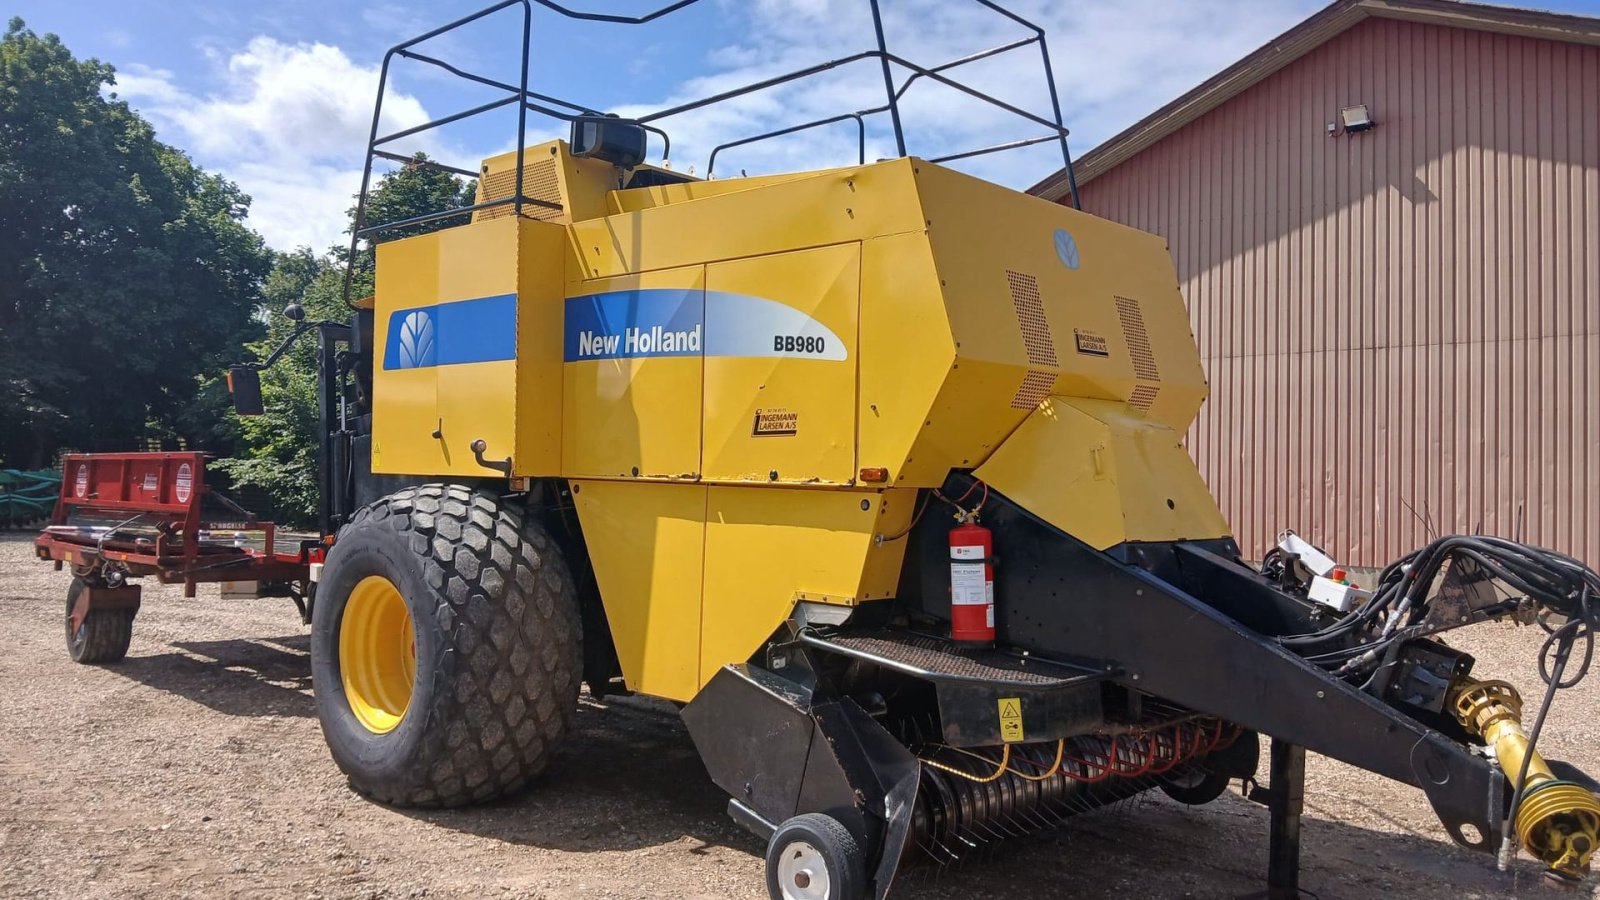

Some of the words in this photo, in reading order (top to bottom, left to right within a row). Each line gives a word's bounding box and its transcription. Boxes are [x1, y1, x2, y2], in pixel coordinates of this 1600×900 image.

[579, 330, 620, 356] New
[625, 324, 701, 353] Holland
[774, 335, 825, 353] BB980
[761, 413, 797, 421] INGEMANN
[759, 422, 784, 430] LARSEN
